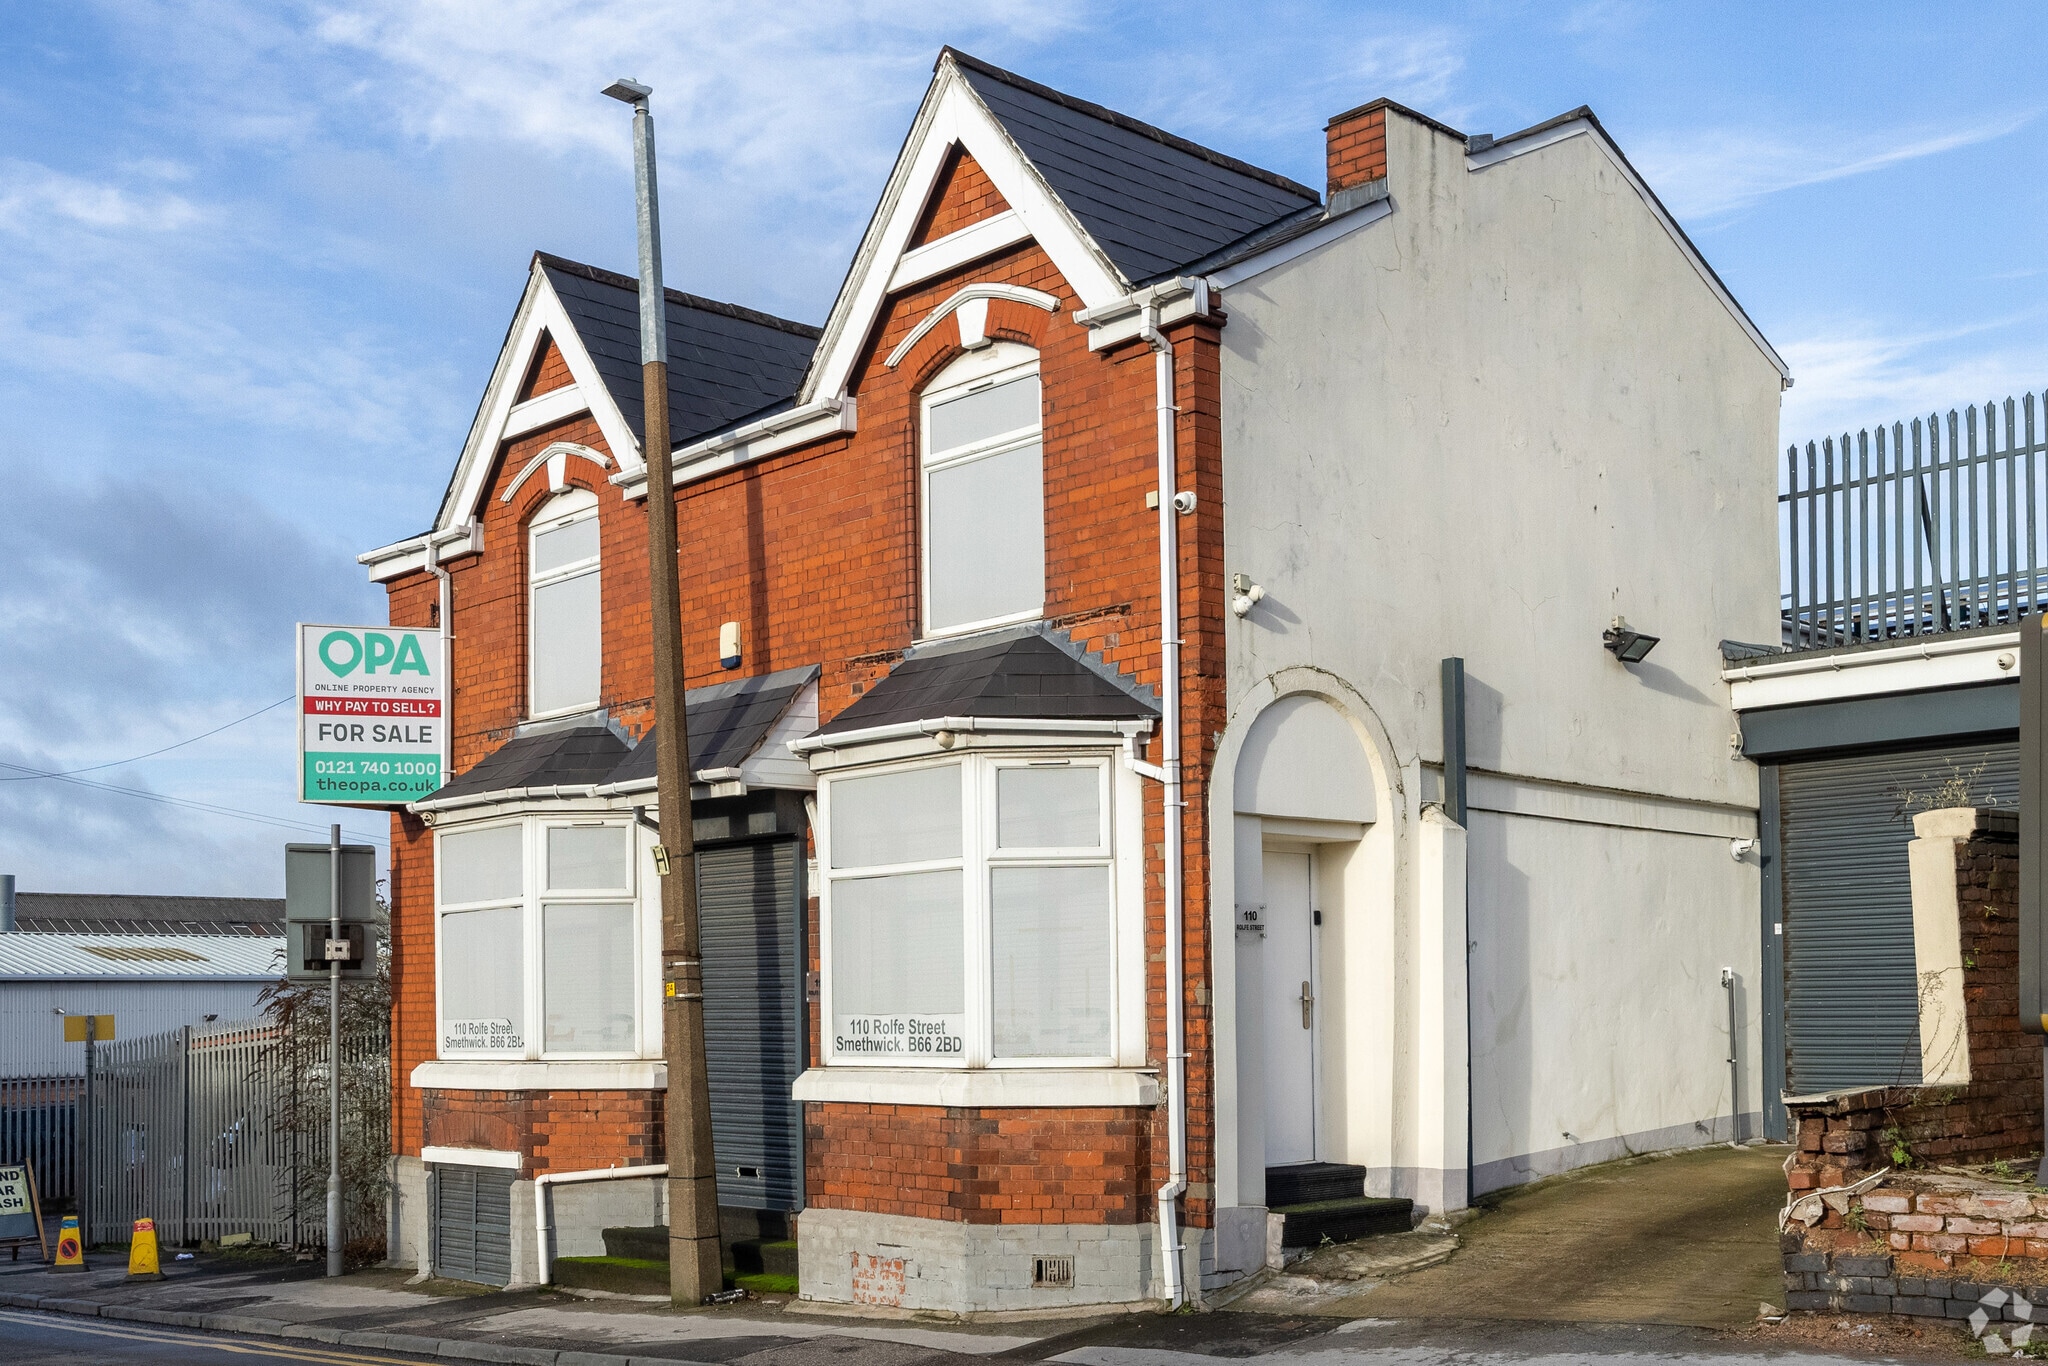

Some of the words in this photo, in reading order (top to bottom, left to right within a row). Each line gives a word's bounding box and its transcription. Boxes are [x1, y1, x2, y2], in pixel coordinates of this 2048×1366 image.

[318, 630, 431, 678] OPA
[315, 683, 348, 692] ONLINE
[353, 684, 397, 693] PROPERTY
[401, 686, 435, 694] AGENCY
[315, 700, 342, 712] WHY
[345, 701, 369, 712] PAY
[372, 701, 389, 713] TO
[392, 702, 435, 714] SELL?
[318, 723, 364, 742] FOR
[372, 724, 432, 743] SALE
[315, 760, 356, 774] 0121
[360, 761, 390, 775] 740
[394, 761, 436, 775] 1000
[316, 777, 435, 794] theopa.co.uk
[1244, 911, 1257, 920] 110
[454, 1022, 466, 1035] 110
[468, 1022, 488, 1035] Rolfe
[490, 1022, 513, 1035] Street
[850, 1019, 869, 1034] 110
[873, 1019, 904, 1034] Rolfe
[908, 1019, 945, 1034] Street
[445, 1036, 488, 1048] Smethwick.
[490, 1036, 505, 1048] B66
[836, 1036, 904, 1052] Smethwick.
[908, 1036, 932, 1052] B66
[935, 1036, 962, 1052] 2BD
